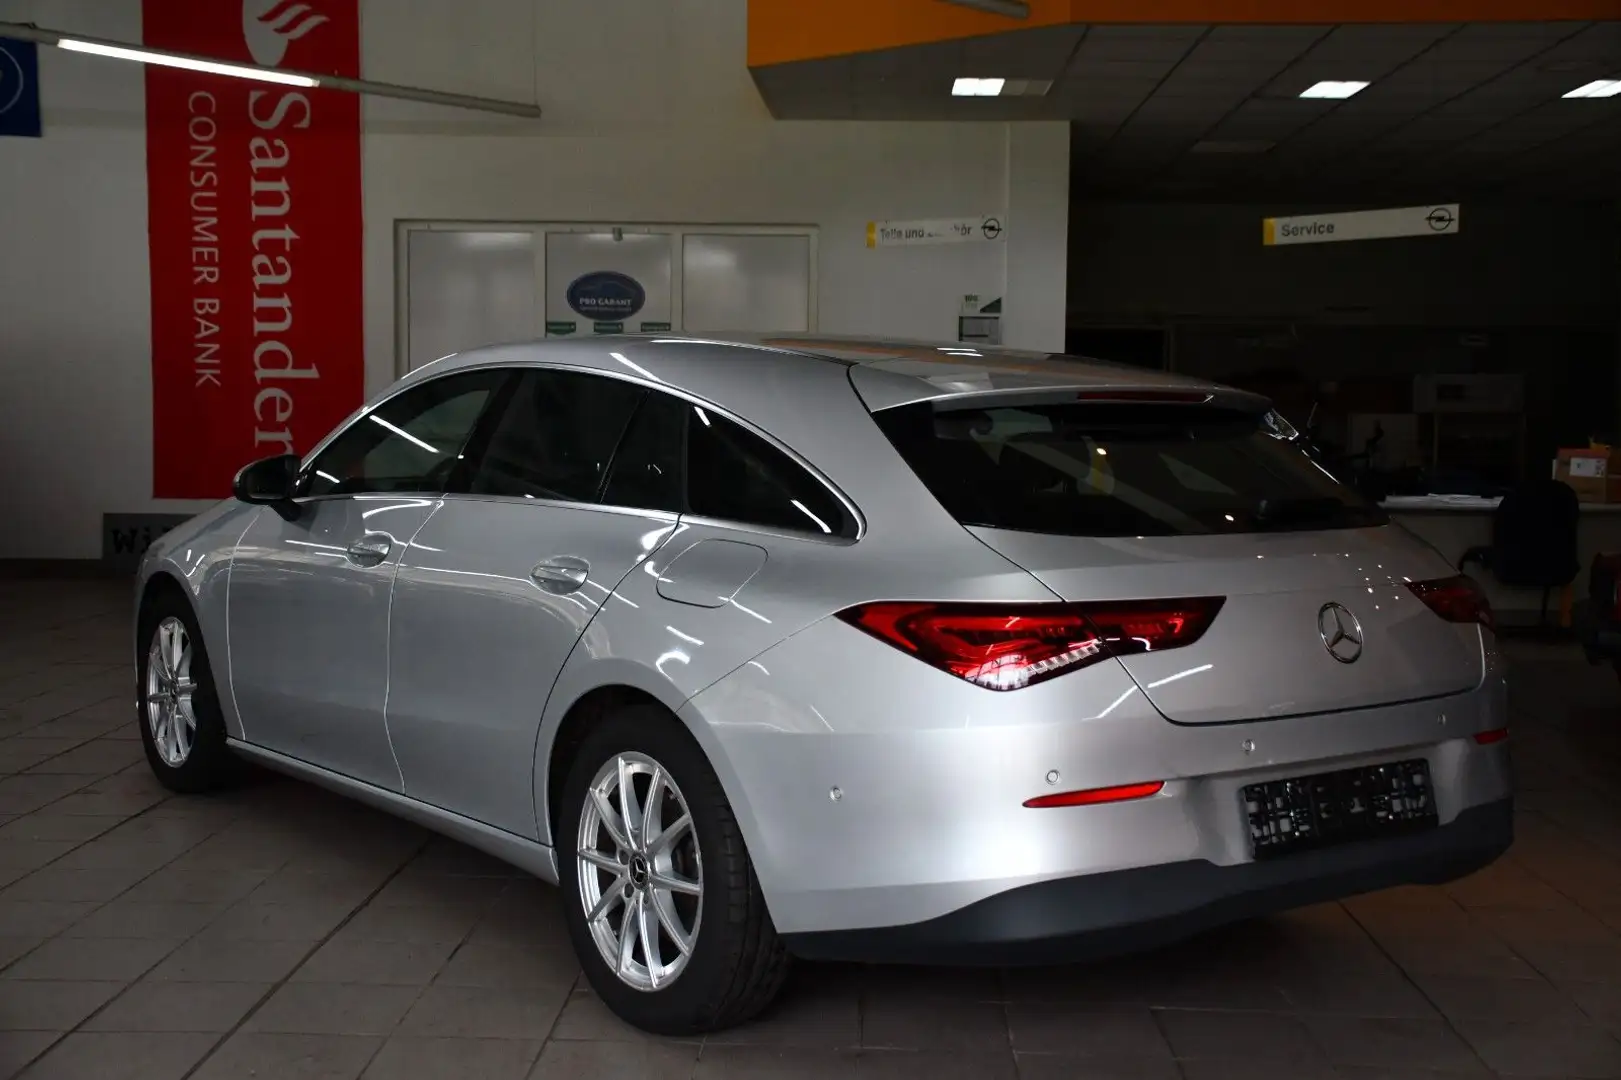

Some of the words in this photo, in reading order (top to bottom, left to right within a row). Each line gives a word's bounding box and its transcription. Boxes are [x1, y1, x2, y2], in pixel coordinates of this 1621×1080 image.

[187, 89, 220, 285] CONSUMER
[905, 228, 925, 239] und
[1281, 222, 1335, 237] Service
[248, 89, 321, 455] Santander
[579, 297, 596, 305] PRO
[192, 298, 223, 388] BANK
